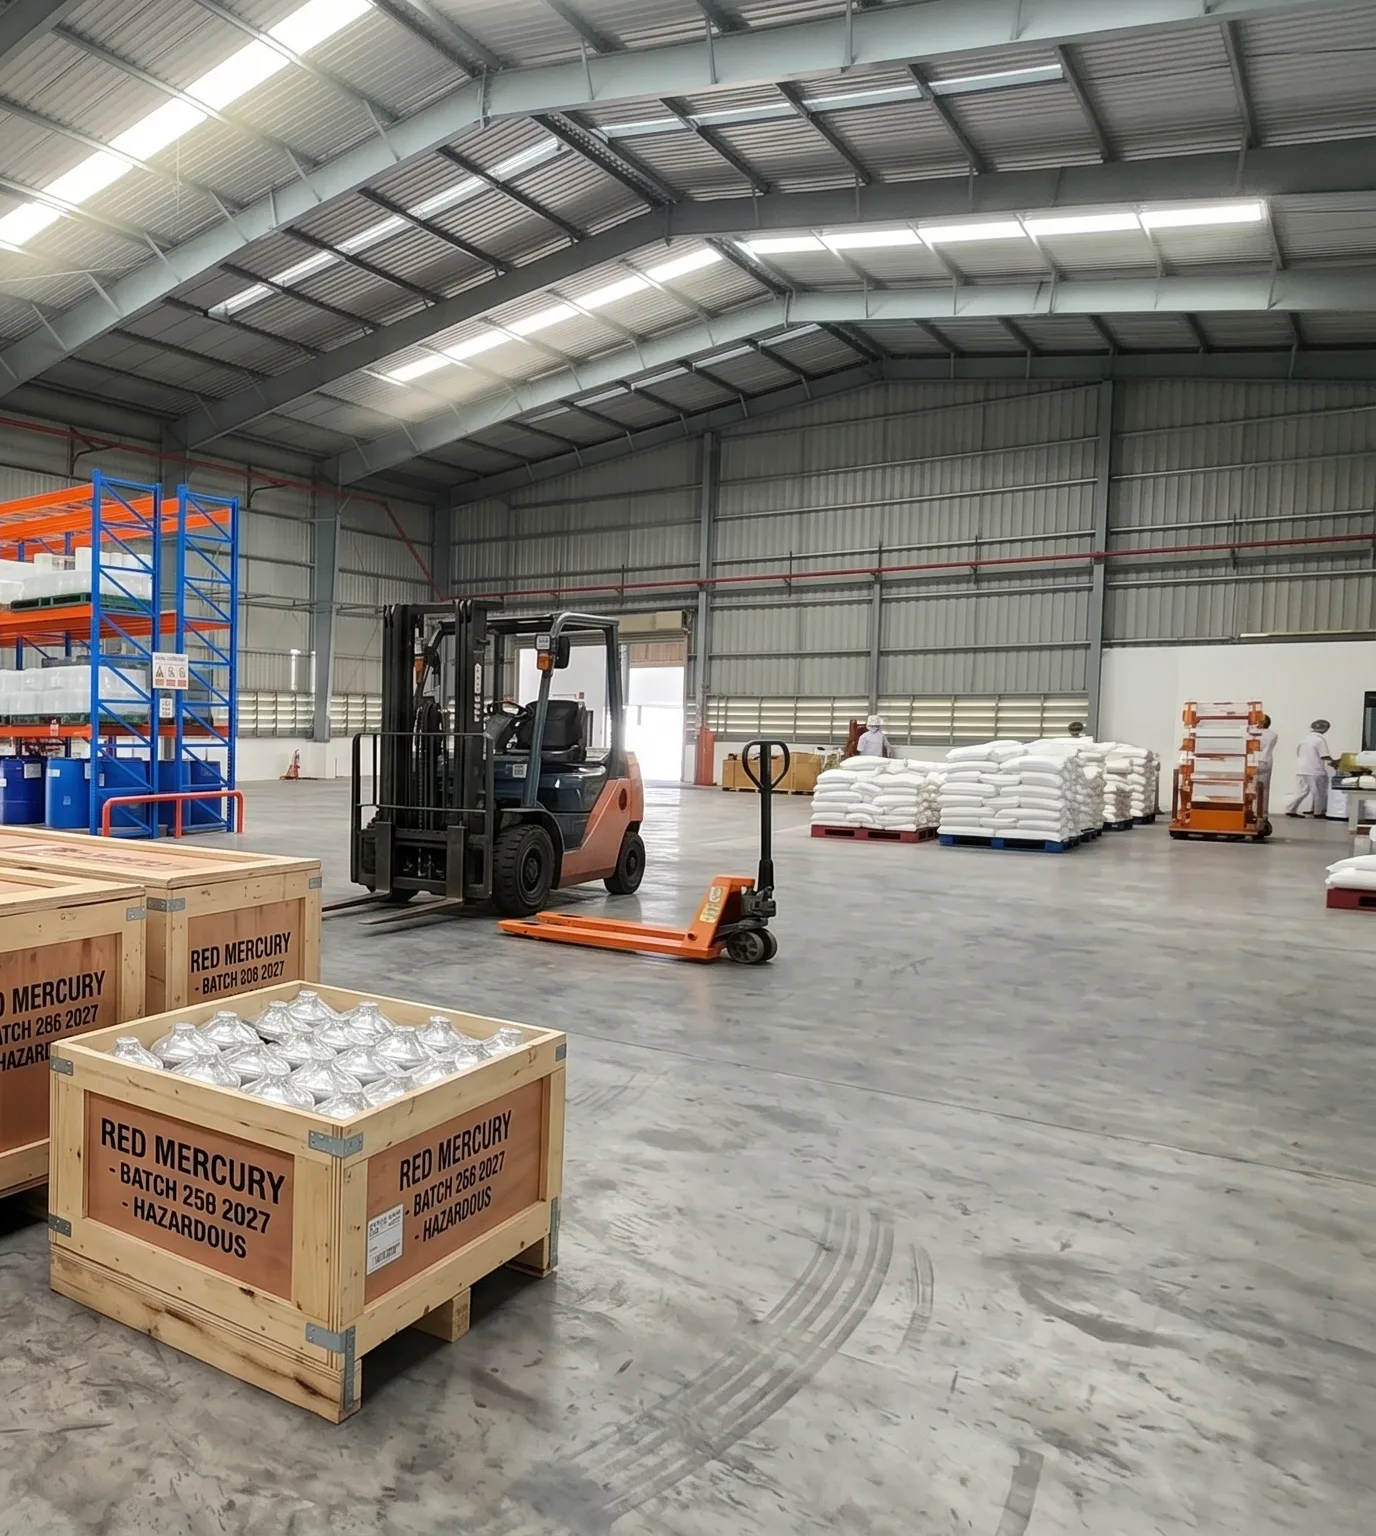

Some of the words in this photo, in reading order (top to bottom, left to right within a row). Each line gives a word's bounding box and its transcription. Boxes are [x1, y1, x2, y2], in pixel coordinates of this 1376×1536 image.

[191, 946, 220, 973] RED
[225, 932, 291, 965] MERCURY
[202, 971, 237, 995] BATCH
[261, 961, 284, 980] 2027
[12, 970, 105, 1014] MERCURY
[65, 1005, 98, 1029] 2027
[101, 1117, 146, 1158] RED
[155, 1134, 285, 1205] MERCURY
[399, 1148, 433, 1192] RED
[437, 1109, 512, 1173] MERCURY
[120, 1161, 177, 1201] BATCH
[221, 1198, 271, 1234] 2027
[413, 1176, 453, 1217] BATCH
[479, 1150, 505, 1182] 2027
[423, 1185, 492, 1242] HAZARDOUS
[133, 1196, 247, 1259] HAZARDOUS
